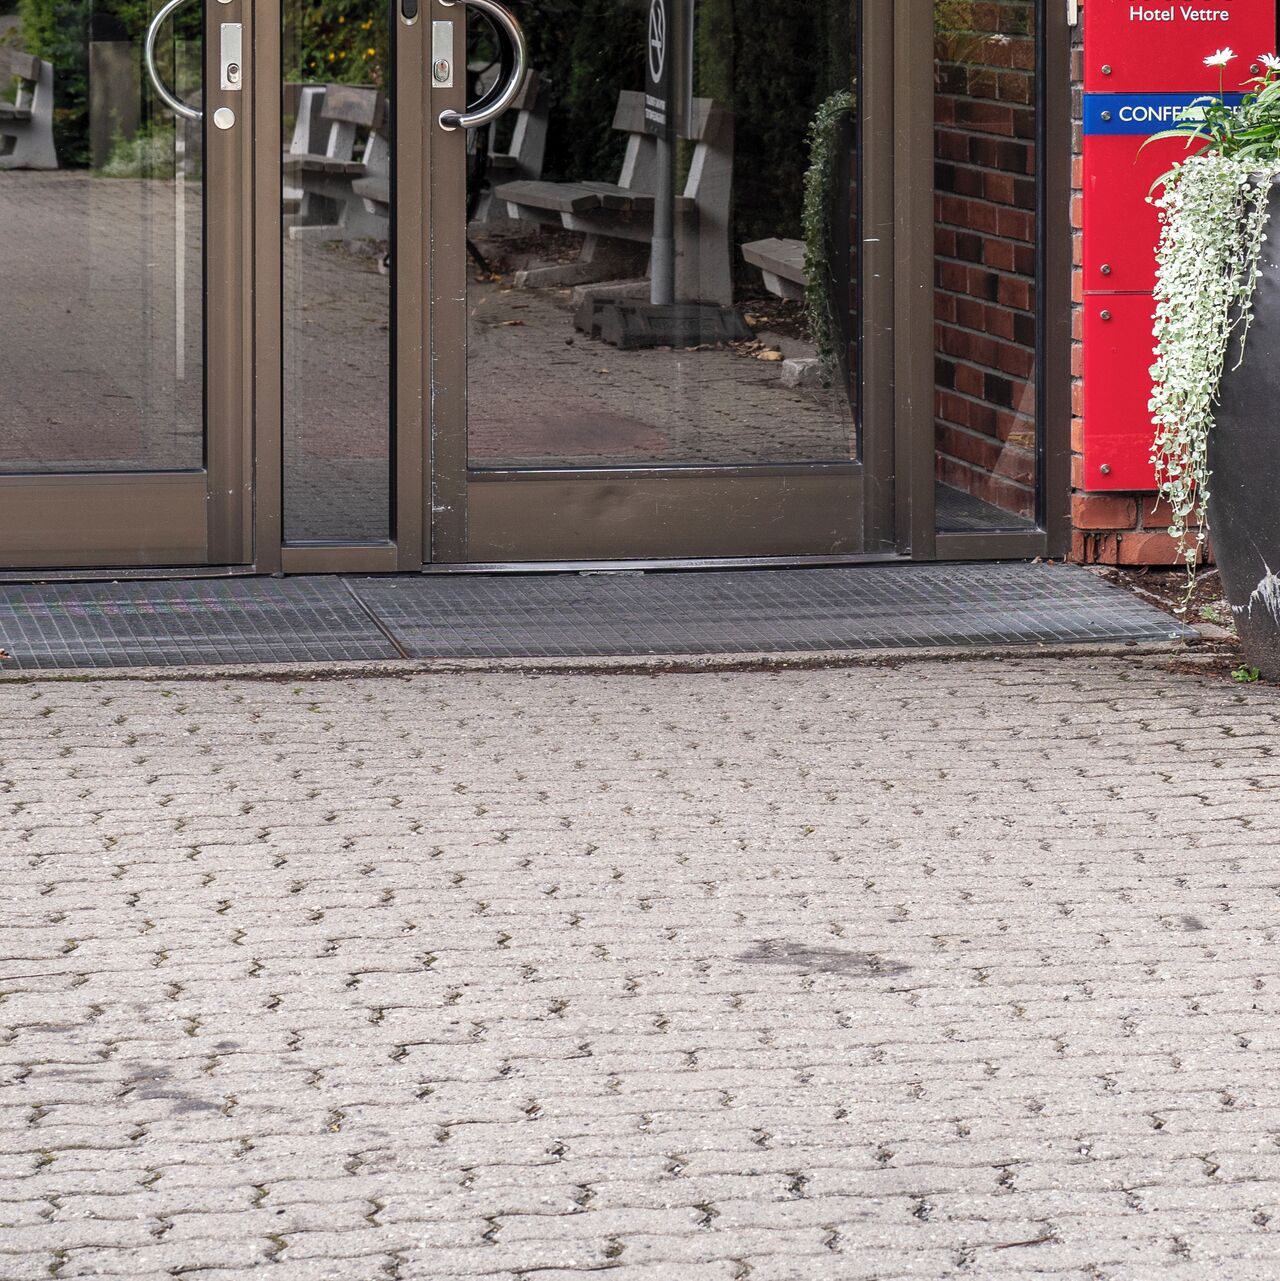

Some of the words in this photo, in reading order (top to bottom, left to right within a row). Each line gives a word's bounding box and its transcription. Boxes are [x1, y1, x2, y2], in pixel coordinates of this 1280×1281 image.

[1130, 6, 1175, 21] Hotel
[1180, 6, 1230, 21] Vettre
[1119, 106, 1241, 122] CONFE
